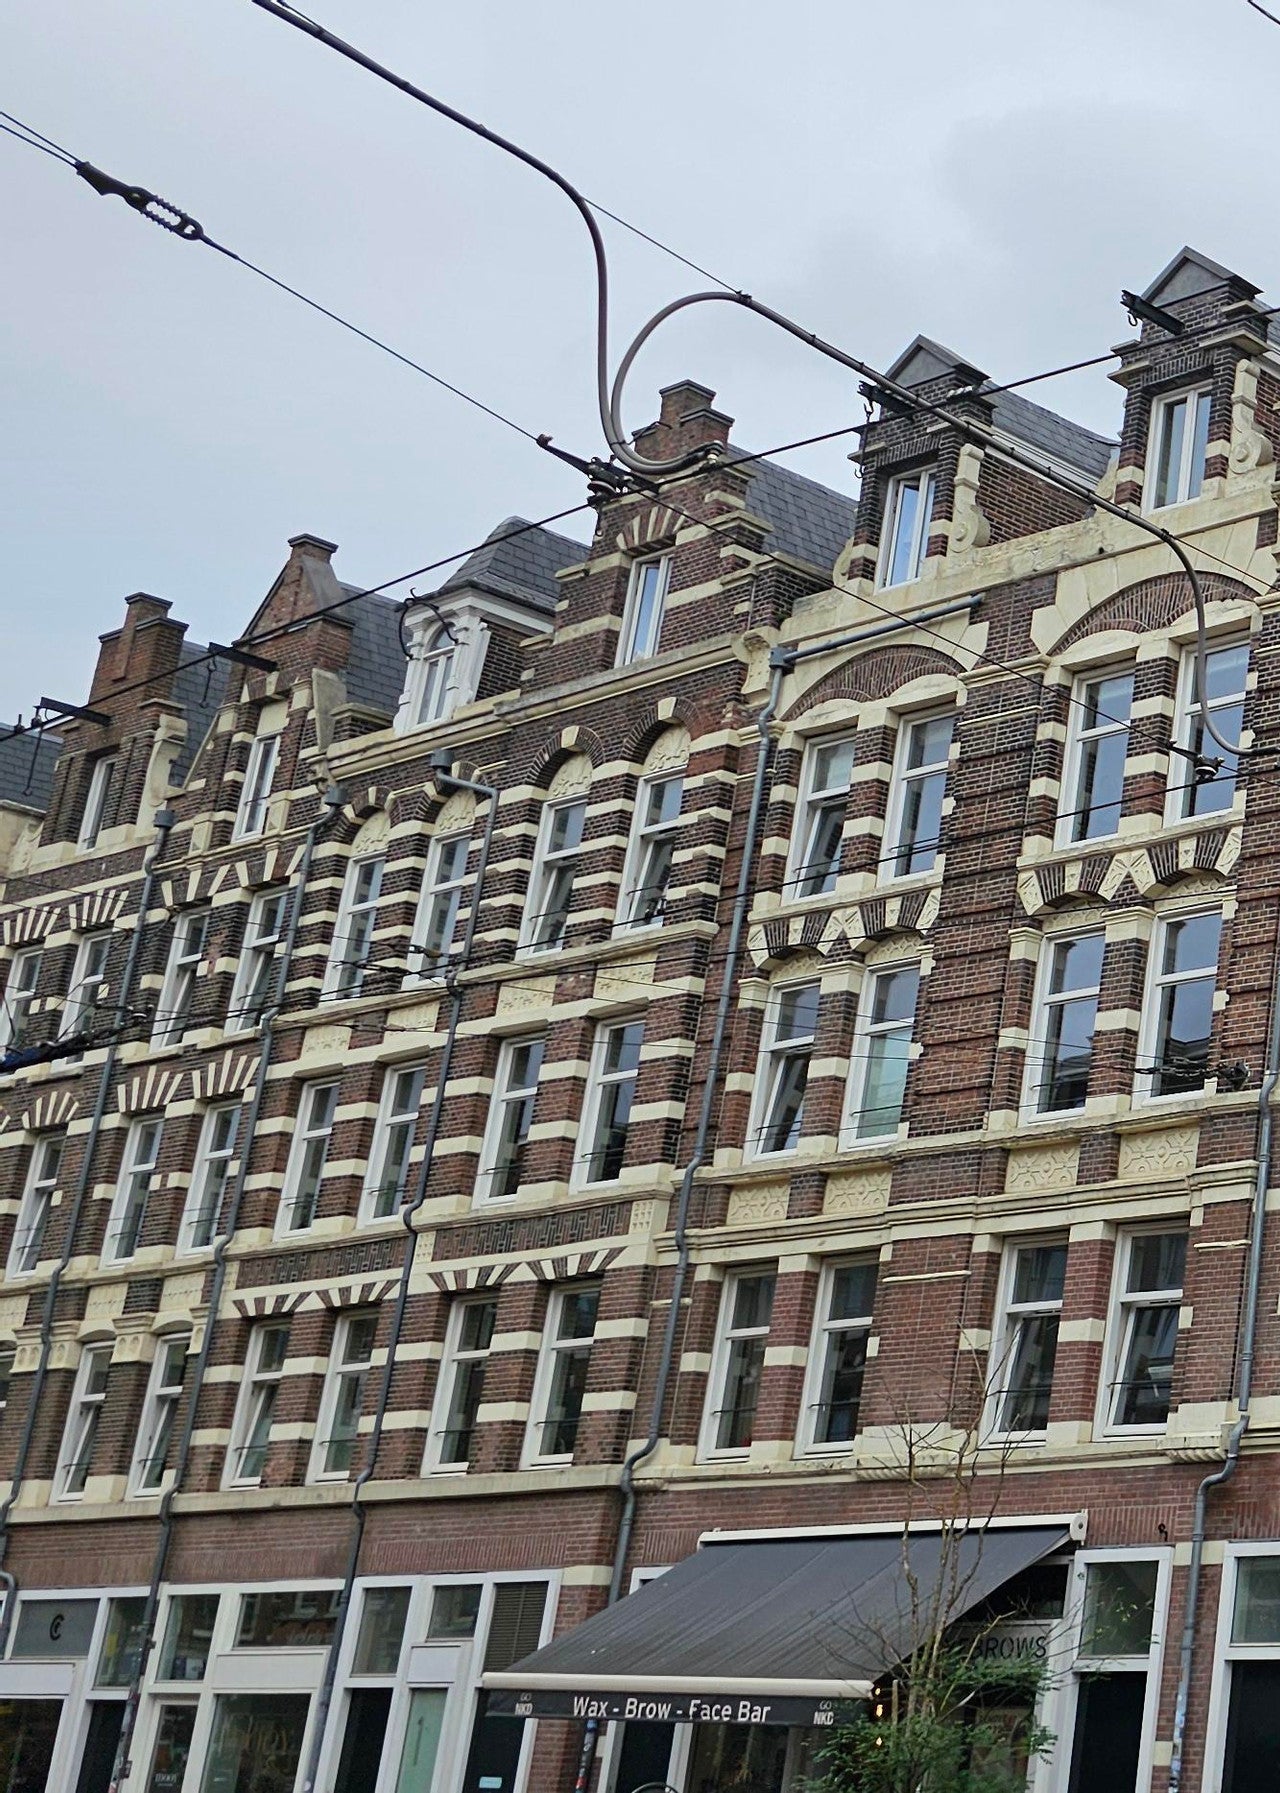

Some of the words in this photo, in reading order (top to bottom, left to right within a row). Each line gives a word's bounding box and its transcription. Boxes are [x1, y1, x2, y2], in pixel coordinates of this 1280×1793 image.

[573, 1696, 608, 1717] Wax
[625, 1697, 671, 1719] Brow
[689, 1699, 732, 1721] Face
[737, 1701, 771, 1723] Bar
